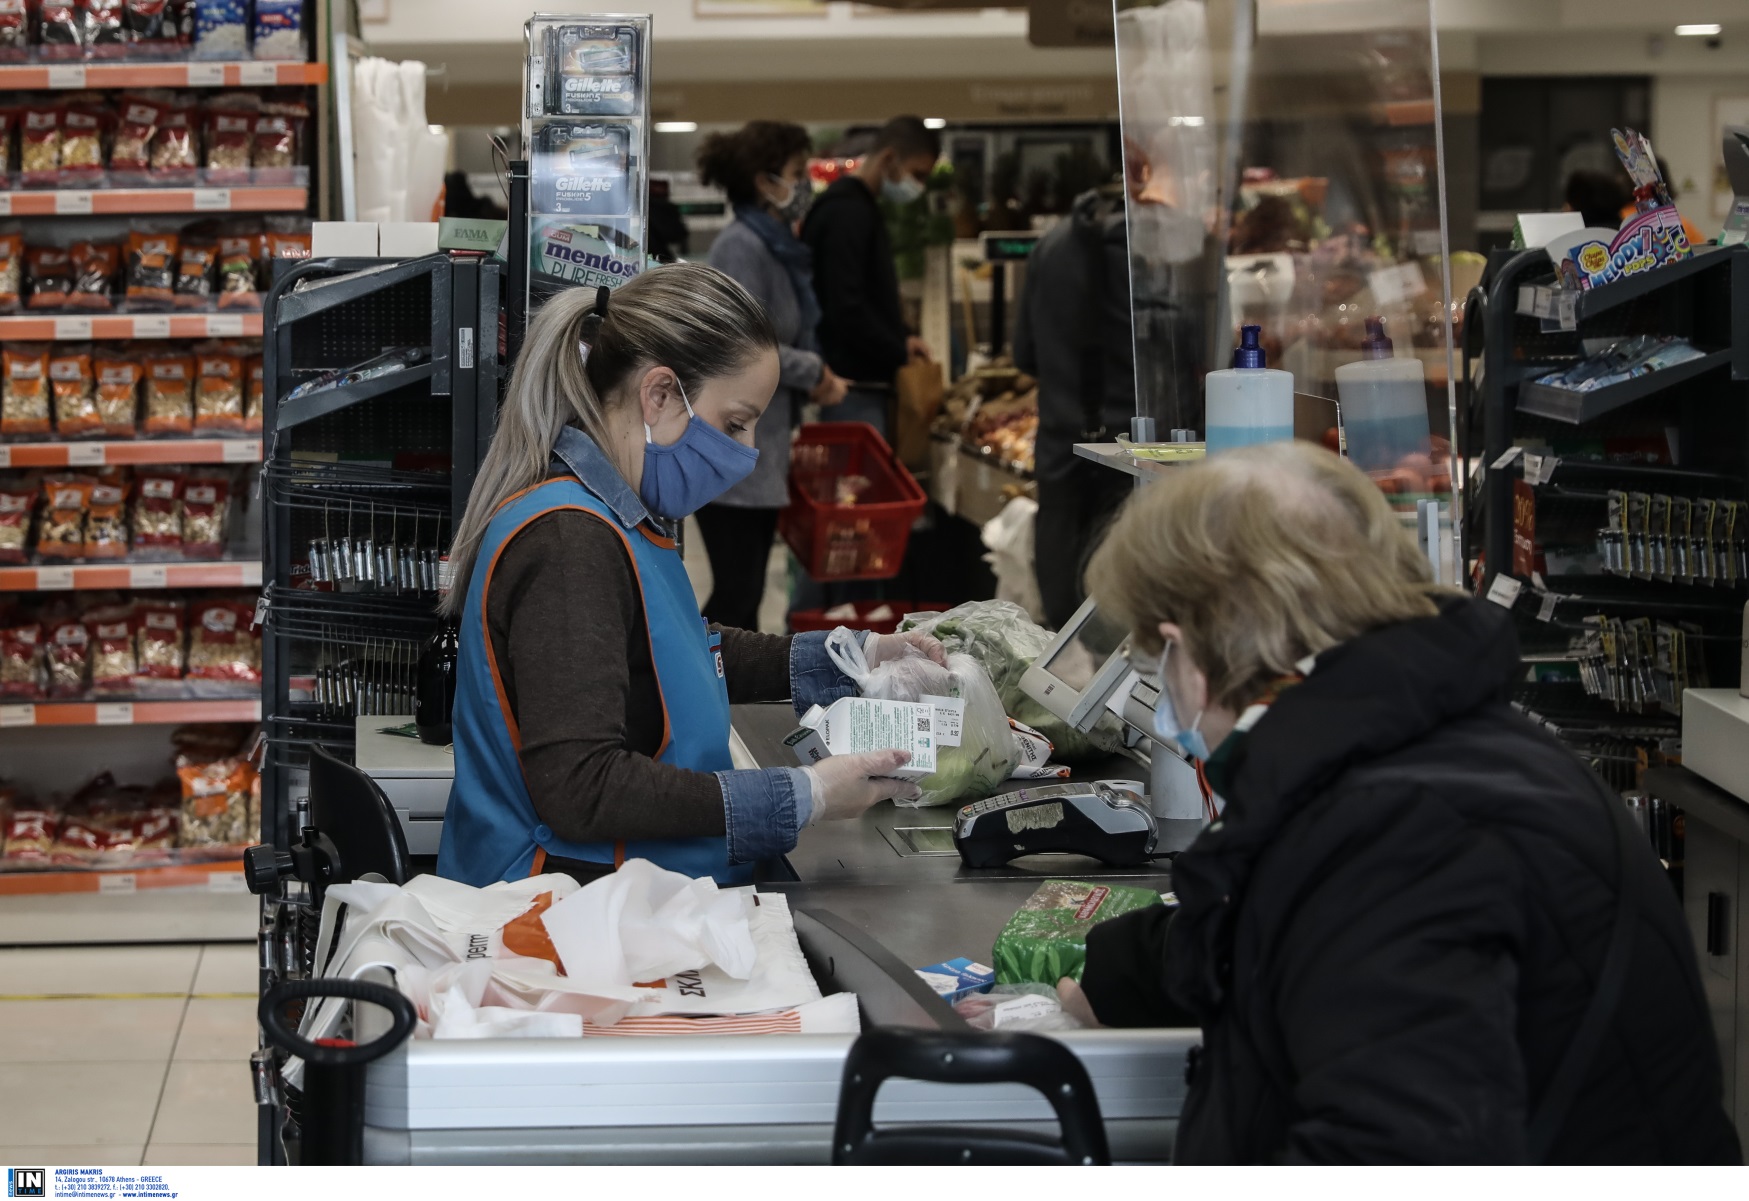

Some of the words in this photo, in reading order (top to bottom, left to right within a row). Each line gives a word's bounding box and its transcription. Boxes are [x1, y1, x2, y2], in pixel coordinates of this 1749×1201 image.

[565, 78, 621, 92] Gillette
[565, 104, 571, 113] 3
[555, 177, 611, 191] Gillette
[556, 202, 561, 212] 3
[454, 228, 489, 240] FAMA
[544, 241, 633, 278] mentos
[1590, 235, 1643, 288] MELODY
[1623, 254, 1656, 275] POPS
[596, 274, 623, 287] FRESH
[289, 564, 311, 576] Trid
